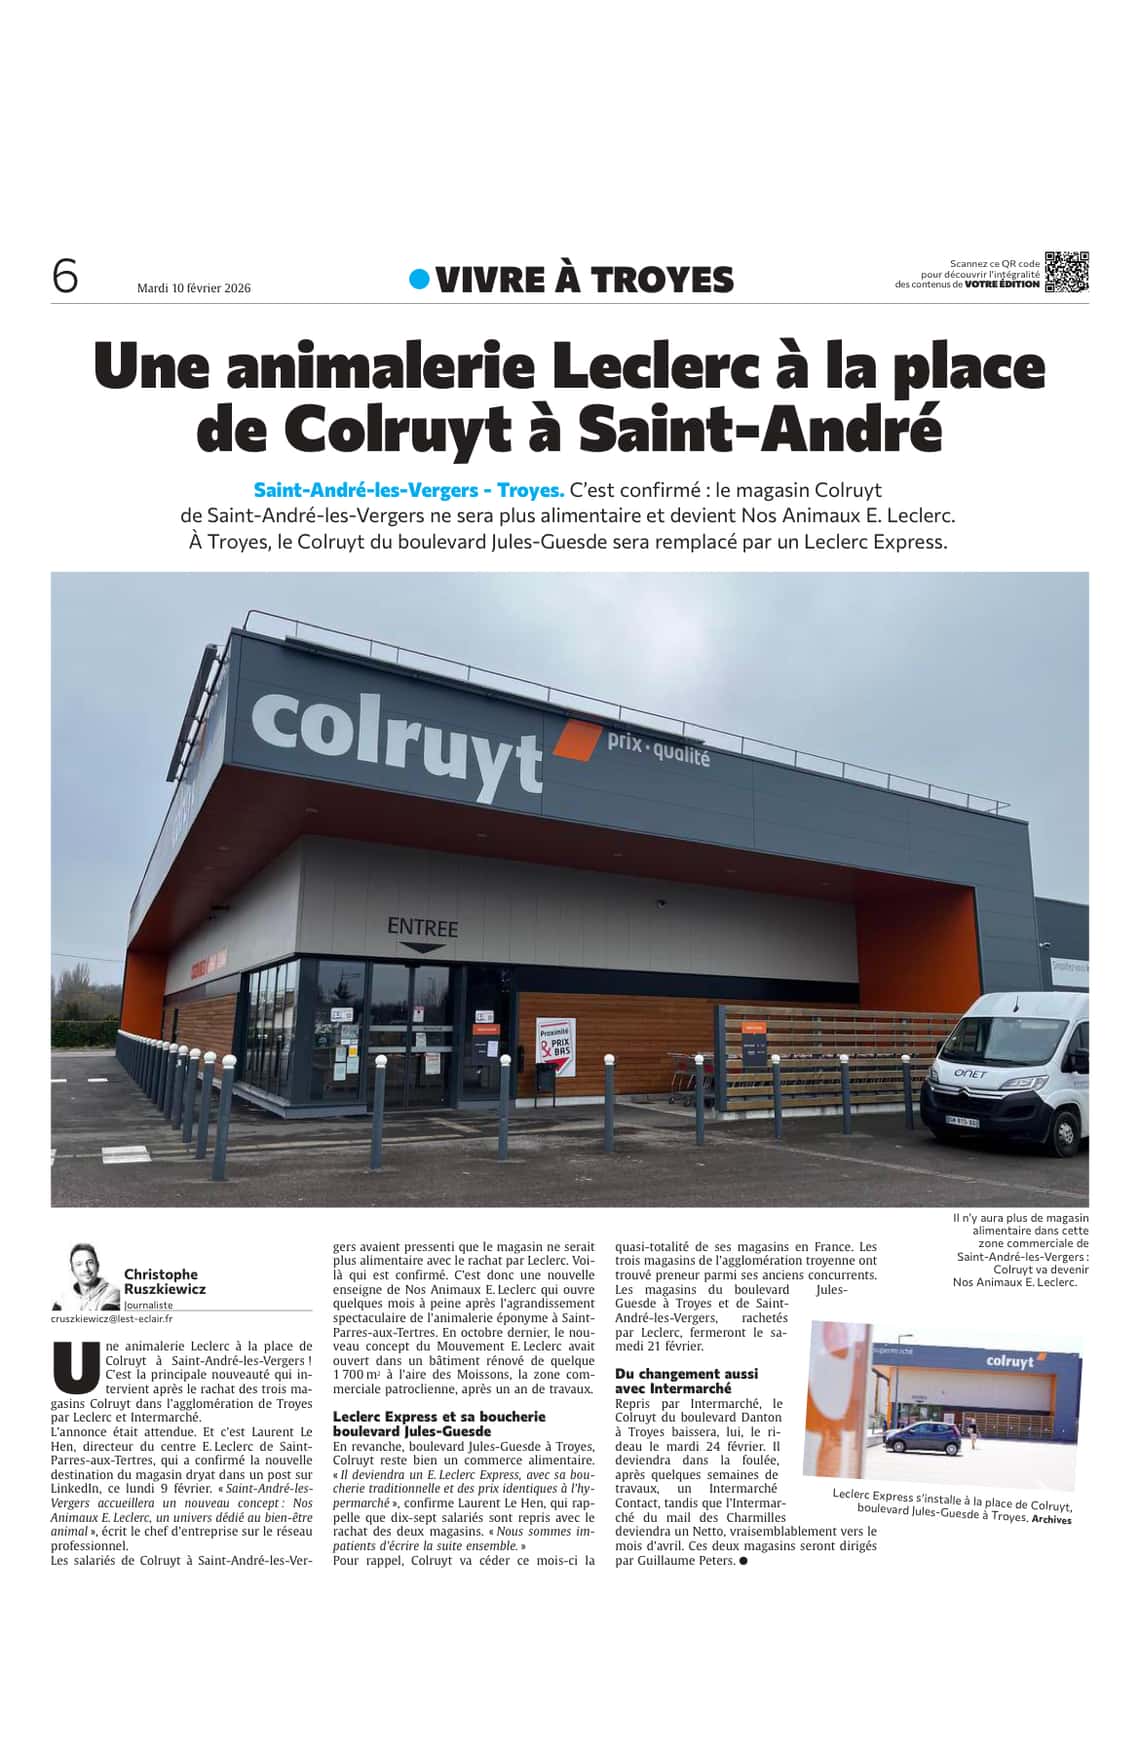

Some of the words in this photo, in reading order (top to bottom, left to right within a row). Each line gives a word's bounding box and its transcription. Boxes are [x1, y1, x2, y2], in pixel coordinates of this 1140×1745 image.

[950, 259, 988, 268] Scannez
[1001, 259, 1017, 269] QR
[1018, 259, 1041, 268] code
[52, 257, 79, 294] 6
[434, 265, 546, 294] VIVRE
[554, 256, 582, 294] À
[590, 265, 735, 294] TROYES
[921, 272, 942, 281] pour
[944, 270, 987, 279] découvrir
[989, 270, 1041, 281] l'intégralité
[137, 282, 169, 294] Mardi
[173, 283, 185, 293] 10
[187, 282, 222, 294] février
[224, 282, 251, 294] 2026
[895, 279, 910, 289] des
[911, 281, 951, 289] contenus
[952, 280, 964, 289] de
[964, 279, 999, 289] VOTRE
[999, 279, 1041, 289] ÉDITION
[94, 340, 210, 390] Une
[226, 338, 536, 390] animalerie
[553, 338, 760, 390] Leclerc
[775, 336, 809, 390] à
[826, 338, 877, 390] la
[893, 338, 1046, 399] place
[196, 402, 268, 453] de
[284, 401, 513, 465] Colruyt
[528, 400, 561, 453] à
[578, 400, 943, 453] Saint-André
[253, 480, 480, 502] Saint-André-les-Vergers
[496, 481, 565, 502] Troyes.
[569, 481, 615, 498] C'est
[620, 480, 701, 498] confirmé
[716, 481, 731, 498] le
[736, 481, 810, 502] magasin
[815, 481, 883, 502] Colruyt
[180, 506, 203, 524] de
[207, 505, 425, 527] Saint-André-les-Vergers
[430, 511, 452, 524] ne
[457, 511, 494, 524] sera
[499, 506, 536, 527] plus
[540, 506, 642, 524] alimentaire
[646, 508, 665, 524] et
[670, 506, 737, 524] devient
[742, 506, 777, 524] Nos
[781, 506, 861, 524] Animaux
[887, 506, 956, 524] Leclerc.
[188, 528, 203, 550] À
[207, 533, 272, 553] Troyes,
[278, 533, 293, 550] le
[297, 532, 365, 553] Colruyt
[370, 533, 393, 550] du
[398, 532, 486, 550] boulevard
[491, 532, 608, 553] Jules-Guesde
[612, 537, 649, 550] sera
[655, 532, 738, 553] remplacé
[742, 537, 772, 553] par
[777, 537, 799, 550] un
[804, 532, 869, 550] Leclerc
[874, 533, 948, 553] Express.
[252, 692, 543, 805] colruyt
[607, 731, 643, 751] prix
[653, 742, 711, 768] qualité
[387, 916, 459, 938] ENTREE
[552, 1039, 570, 1047] PRIX
[554, 1047, 570, 1056] BAS
[953, 1213, 960, 1223] Il
[962, 1213, 978, 1225] n'y
[980, 1215, 1004, 1223] aura
[1006, 1213, 1028, 1225] plus
[1030, 1213, 1044, 1223] de
[1046, 1212, 1090, 1225] magasin
[972, 1225, 1032, 1236] alimentaire
[1034, 1225, 1059, 1236] dans
[1061, 1226, 1089, 1236] cette
[615, 1240, 689, 1255] quasi-totalité
[694, 1240, 709, 1252] de
[714, 1243, 732, 1252] ses
[737, 1241, 790, 1254] magasins
[794, 1243, 809, 1252] en
[814, 1241, 855, 1252] France.
[859, 1241, 878, 1252] Les
[978, 1240, 1004, 1248] zone
[1006, 1238, 1074, 1248] commerciale
[1076, 1238, 1089, 1248] de
[124, 1267, 199, 1284] Christophe
[993, 1264, 1034, 1277] Colruyt
[1035, 1266, 1048, 1275] va
[1050, 1264, 1089, 1275] devenir
[124, 1281, 207, 1295] Ruszkiewicz
[953, 1277, 974, 1287] Nos
[976, 1277, 1023, 1287] Animaux
[1037, 1277, 1078, 1287] Leclerc.
[124, 1301, 173, 1311] Journaliste
[50, 1313, 173, 1324] cruszkiewicz@lest-eclair.fr
[333, 1327, 439, 1338] Parres-aux-Tertres.
[442, 1327, 457, 1338] En
[460, 1326, 504, 1338] octobre
[507, 1326, 551, 1339] dernier,
[554, 1326, 565, 1338] le
[569, 1329, 596, 1338] nou-
[124, 1340, 185, 1352] animalerie
[191, 1340, 230, 1352] Leclerc
[235, 1340, 242, 1352] à
[247, 1340, 258, 1352] la
[263, 1340, 294, 1354] place
[298, 1340, 313, 1352] de
[986, 1354, 1035, 1371] colruyt
[615, 1367, 635, 1380] Du
[638, 1367, 721, 1382] changement
[724, 1367, 759, 1380] aussi
[615, 1385, 646, 1395] avec
[650, 1380, 732, 1395] Intermarché
[332, 1410, 381, 1423] Leclerc
[384, 1410, 438, 1425] Express
[442, 1410, 457, 1423] et
[460, 1413, 476, 1423] sa
[479, 1410, 547, 1423] boucherie
[332, 1424, 401, 1438] boulevard
[404, 1424, 492, 1440] Jules-Guesde
[832, 1487, 870, 1500] Leclerc
[872, 1490, 914, 1503] Express
[916, 1493, 962, 1506] s'installe
[964, 1495, 971, 1506] à
[973, 1496, 983, 1507] la
[984, 1497, 1013, 1509] place
[1015, 1499, 1028, 1510] de
[1030, 1500, 1073, 1513] Colruyt,
[857, 1502, 910, 1516] boulevard
[911, 1505, 980, 1519] Jules-Guesde
[982, 1509, 989, 1520] à
[991, 1510, 1030, 1524] Troyes.
[1031, 1514, 1073, 1525] Archives
[50, 1555, 69, 1566] Les
[73, 1554, 116, 1566] salariés
[121, 1554, 135, 1566] de
[139, 1554, 181, 1569] Colruyt
[186, 1554, 193, 1566] à
[198, 1554, 313, 1566] Saint-André-les-Ver-
